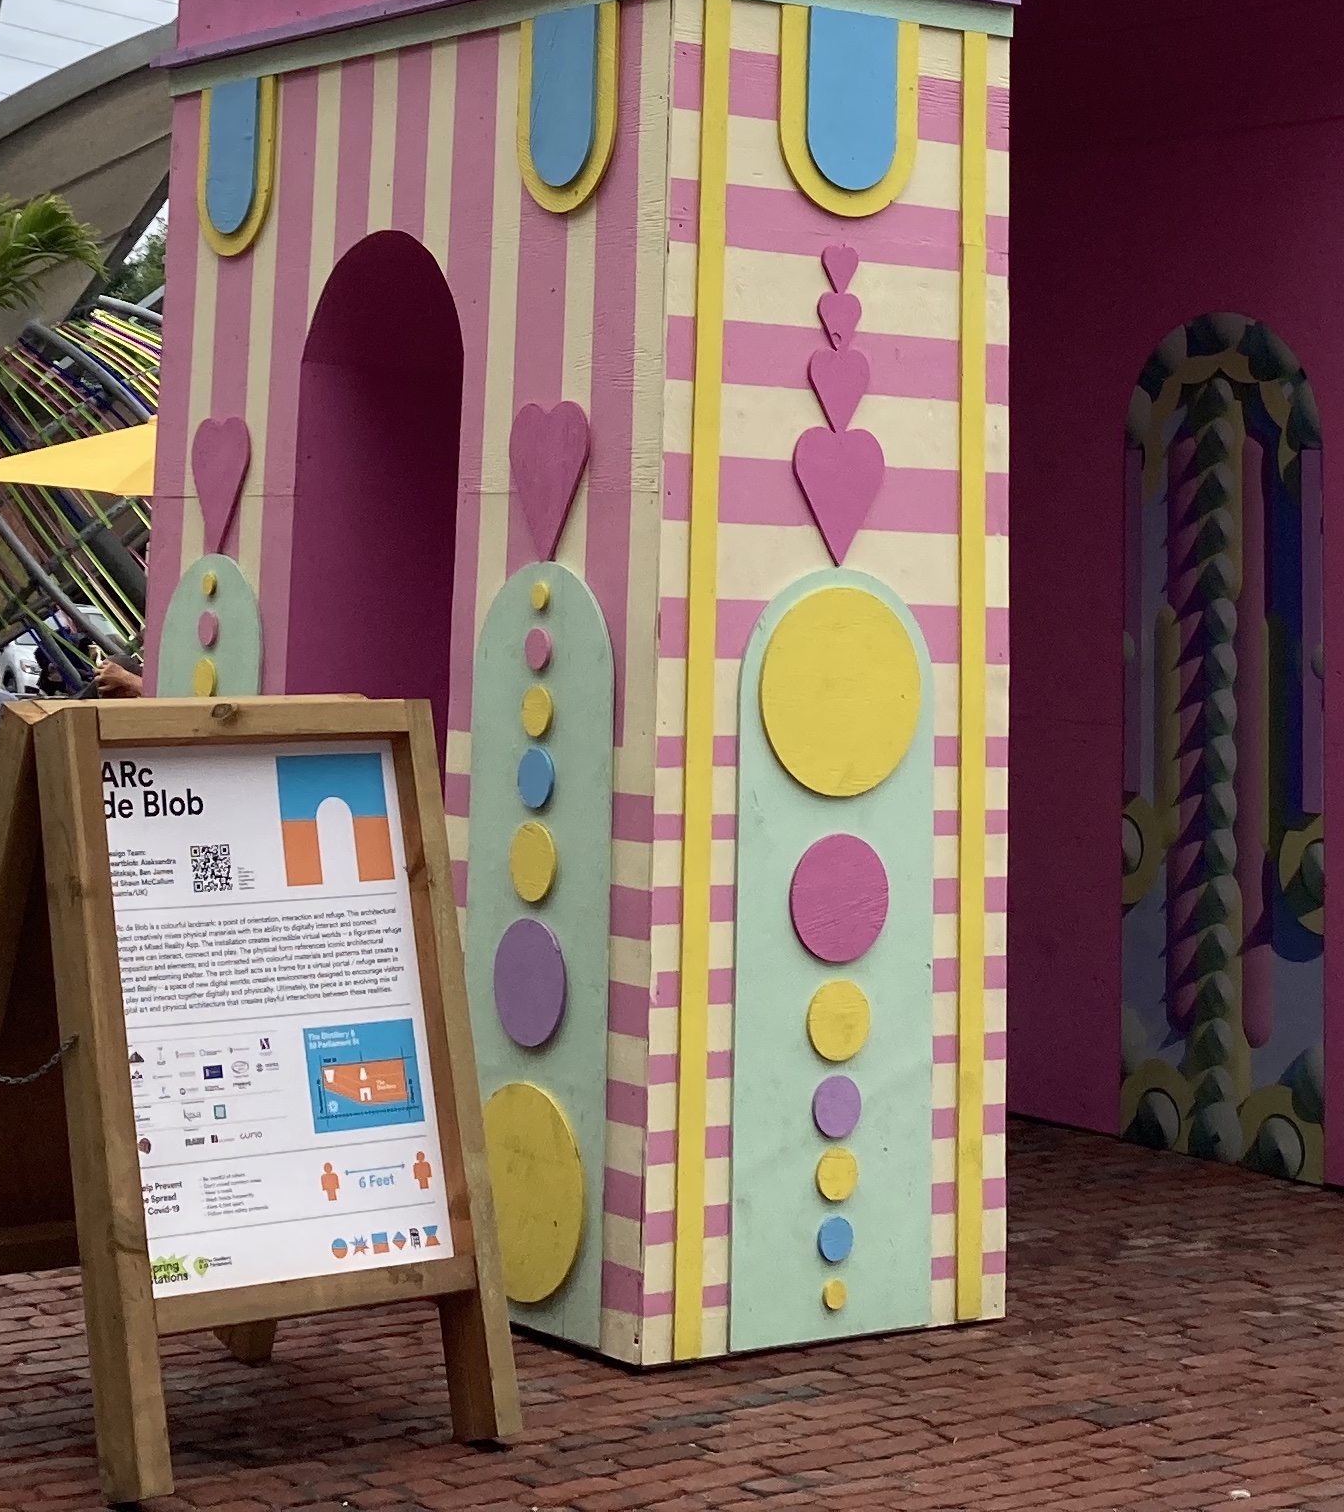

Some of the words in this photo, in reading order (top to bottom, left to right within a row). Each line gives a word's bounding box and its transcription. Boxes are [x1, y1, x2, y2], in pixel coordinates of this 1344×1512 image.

[101, 760, 153, 788] ARc
[103, 791, 133, 819] de
[143, 788, 203, 817] Blob
[142, 1183, 153, 1194] elp
[155, 1180, 182, 1190] Prevent
[359, 1176, 366, 1188] 6
[369, 1173, 395, 1187] Feet
[150, 1192, 177, 1204] Spread
[147, 1204, 180, 1215] Covid-19
[153, 1260, 180, 1275] pring
[152, 1272, 188, 1285] tations
